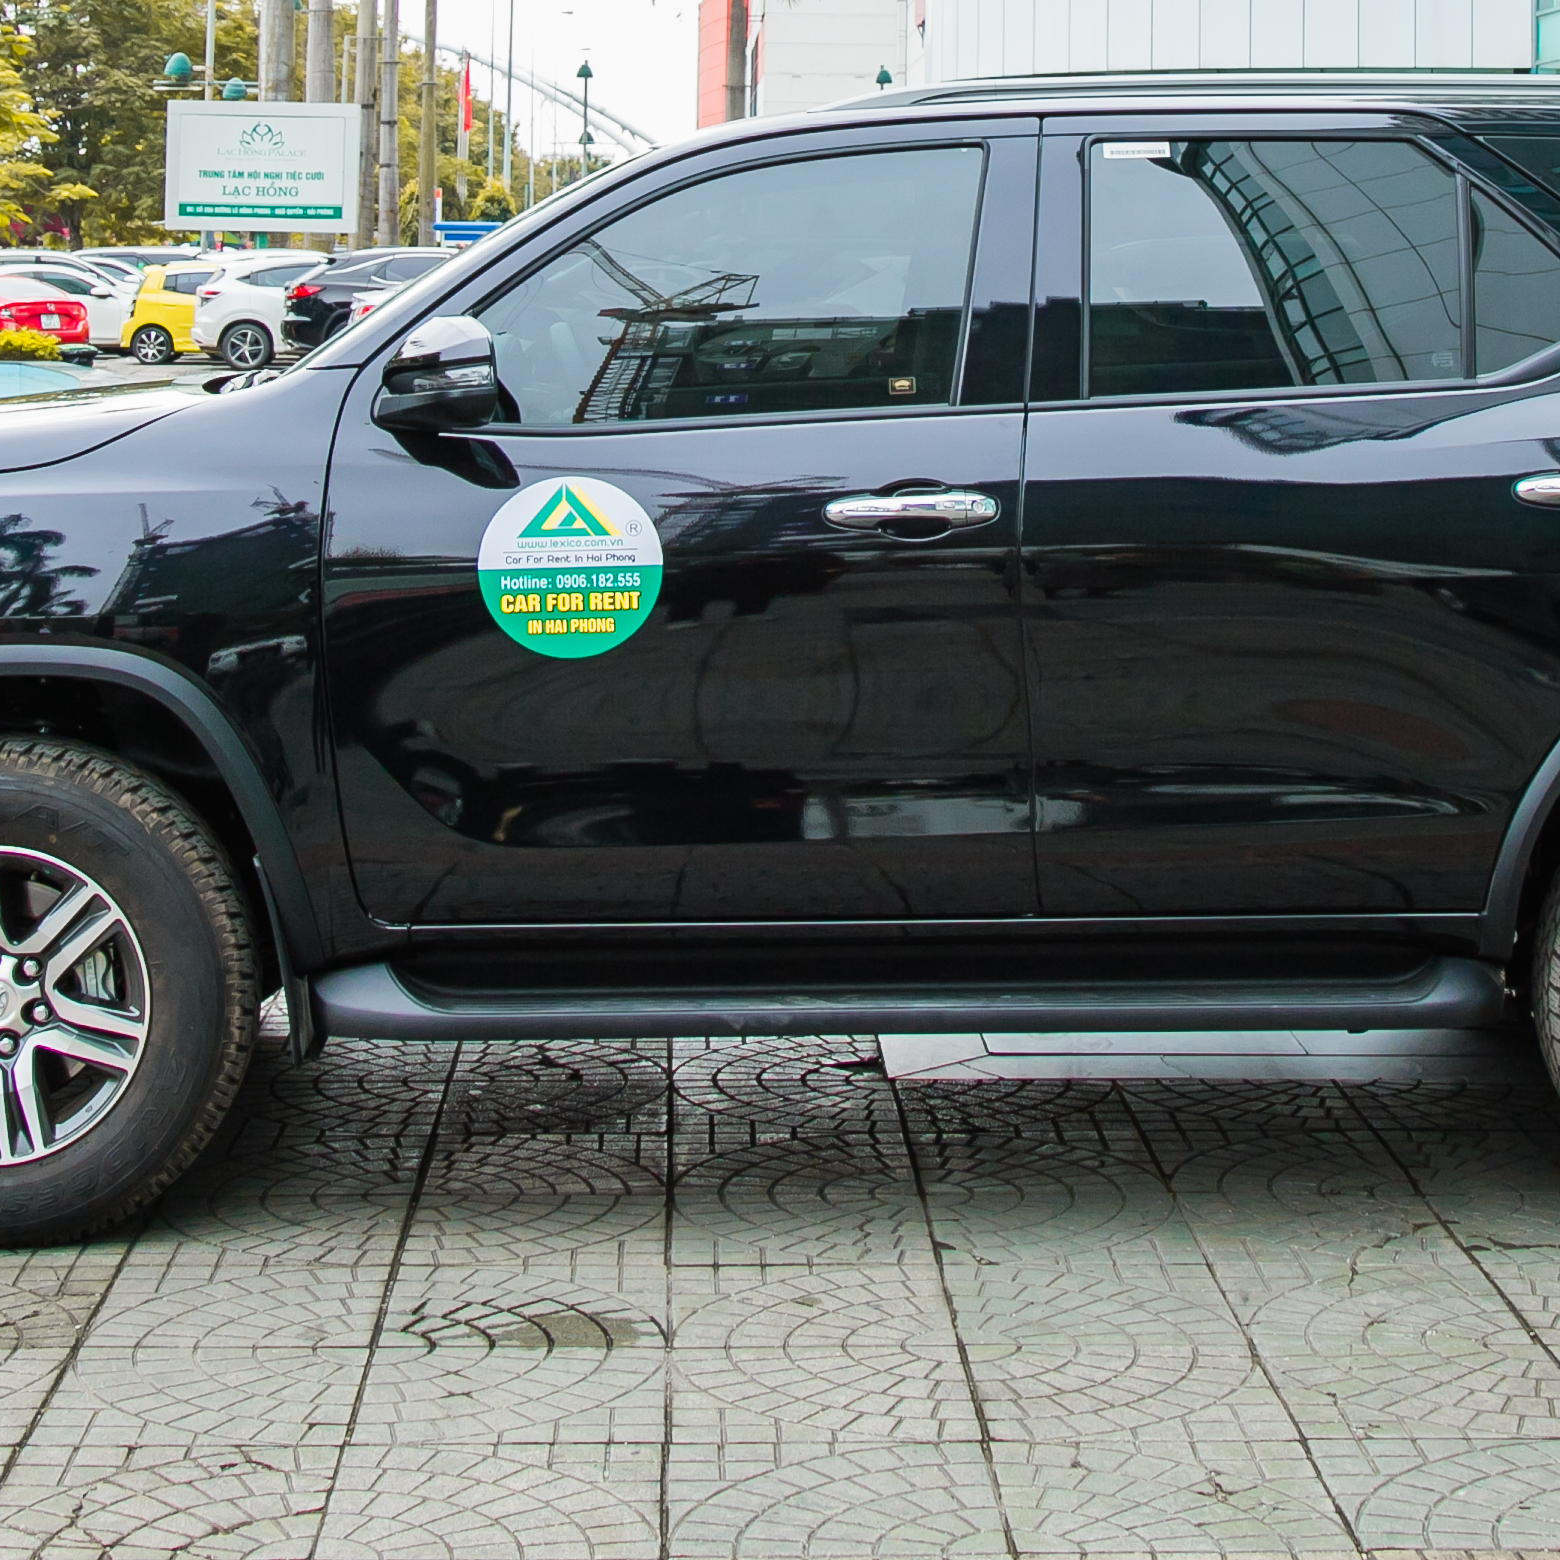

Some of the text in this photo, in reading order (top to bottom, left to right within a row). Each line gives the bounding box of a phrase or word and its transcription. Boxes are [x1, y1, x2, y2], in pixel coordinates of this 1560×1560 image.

[198, 169, 225, 179] TRUNG
[227, 168, 245, 180] TÂM
[222, 185, 251, 199] LẠC
[517, 537, 623, 549] www.lexico.com.vn
[505, 555, 521, 565] Car
[526, 555, 544, 564] For
[547, 554, 571, 564] Rent
[574, 554, 583, 563] In
[605, 553, 636, 564] Phong
[500, 572, 641, 590] Hotline: 0906.182.555
[500, 591, 641, 614] CAR FOR RENT
[527, 617, 615, 635] IN HAI PHONG
